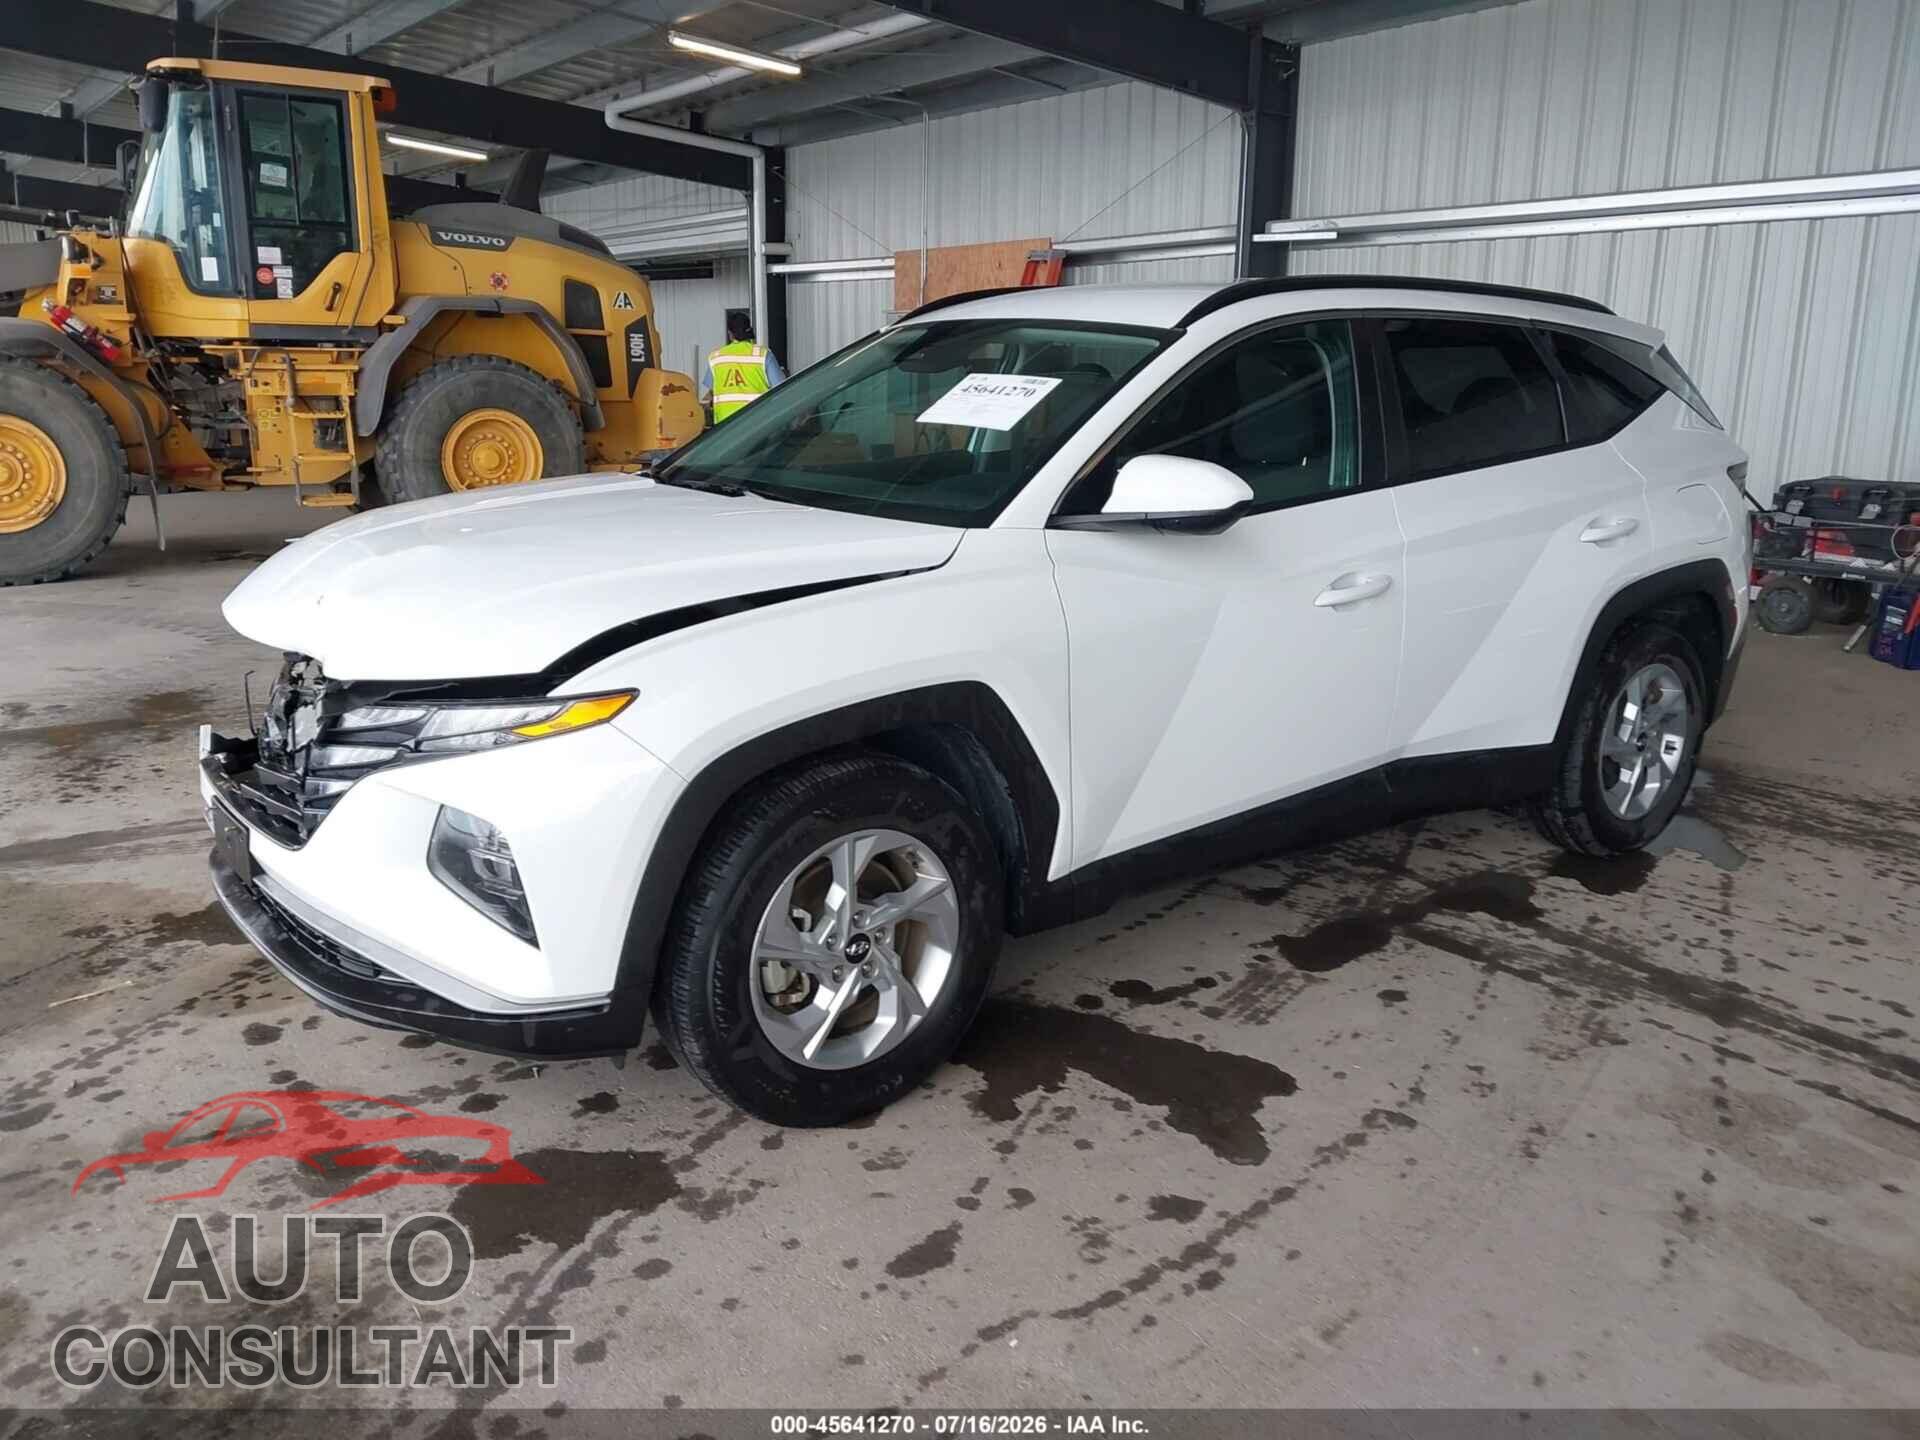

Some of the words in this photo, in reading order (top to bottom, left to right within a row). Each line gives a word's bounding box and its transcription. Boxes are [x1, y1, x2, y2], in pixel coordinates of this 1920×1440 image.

[437, 231, 506, 246] VOLVO
[629, 333, 645, 362] L90H
[961, 383, 1037, 398] 45641270
